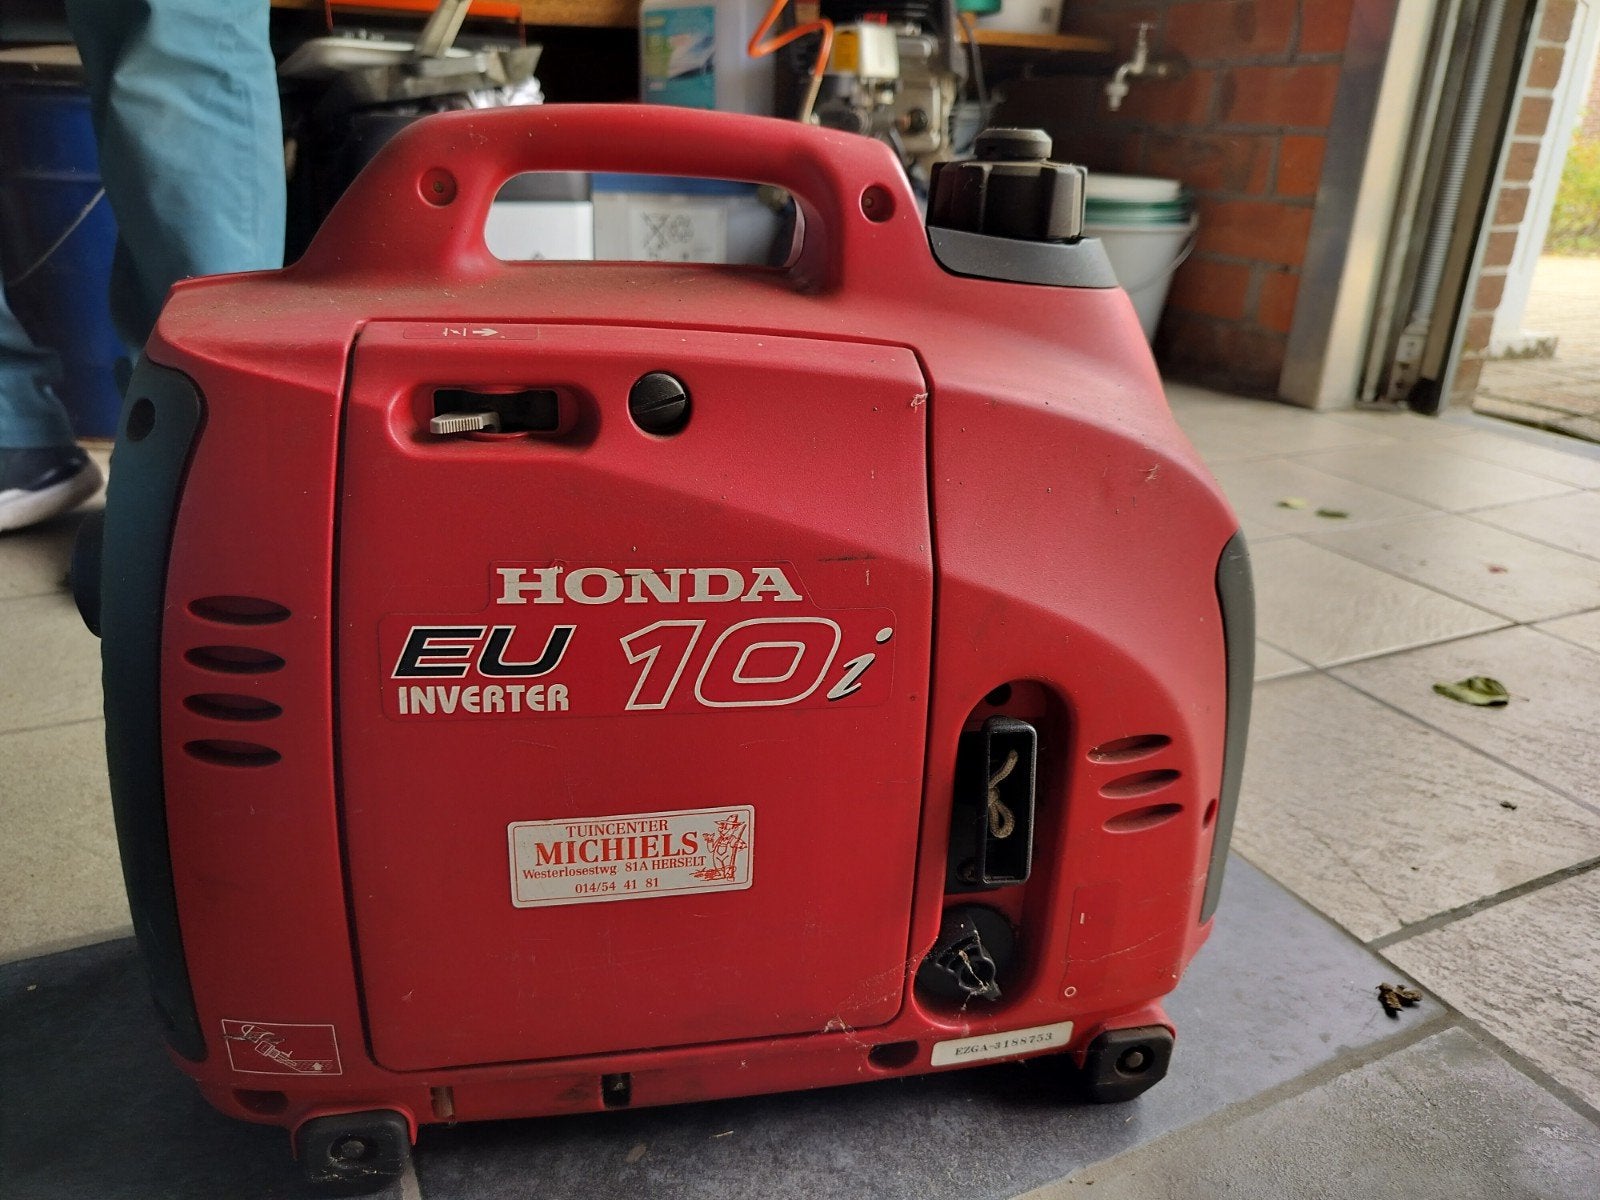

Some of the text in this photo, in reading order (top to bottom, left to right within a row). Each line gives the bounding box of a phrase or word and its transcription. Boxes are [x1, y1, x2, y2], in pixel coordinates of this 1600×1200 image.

[496, 567, 802, 604] HONDA
[391, 624, 577, 679] EU
[398, 684, 569, 714] INVERTER
[565, 819, 669, 838] TUINCENTER
[534, 831, 699, 867] MICHIELS
[522, 864, 618, 880] Westerlosestwg
[651, 855, 707, 871] HERSELT
[575, 877, 659, 894] 014/54 41 81
